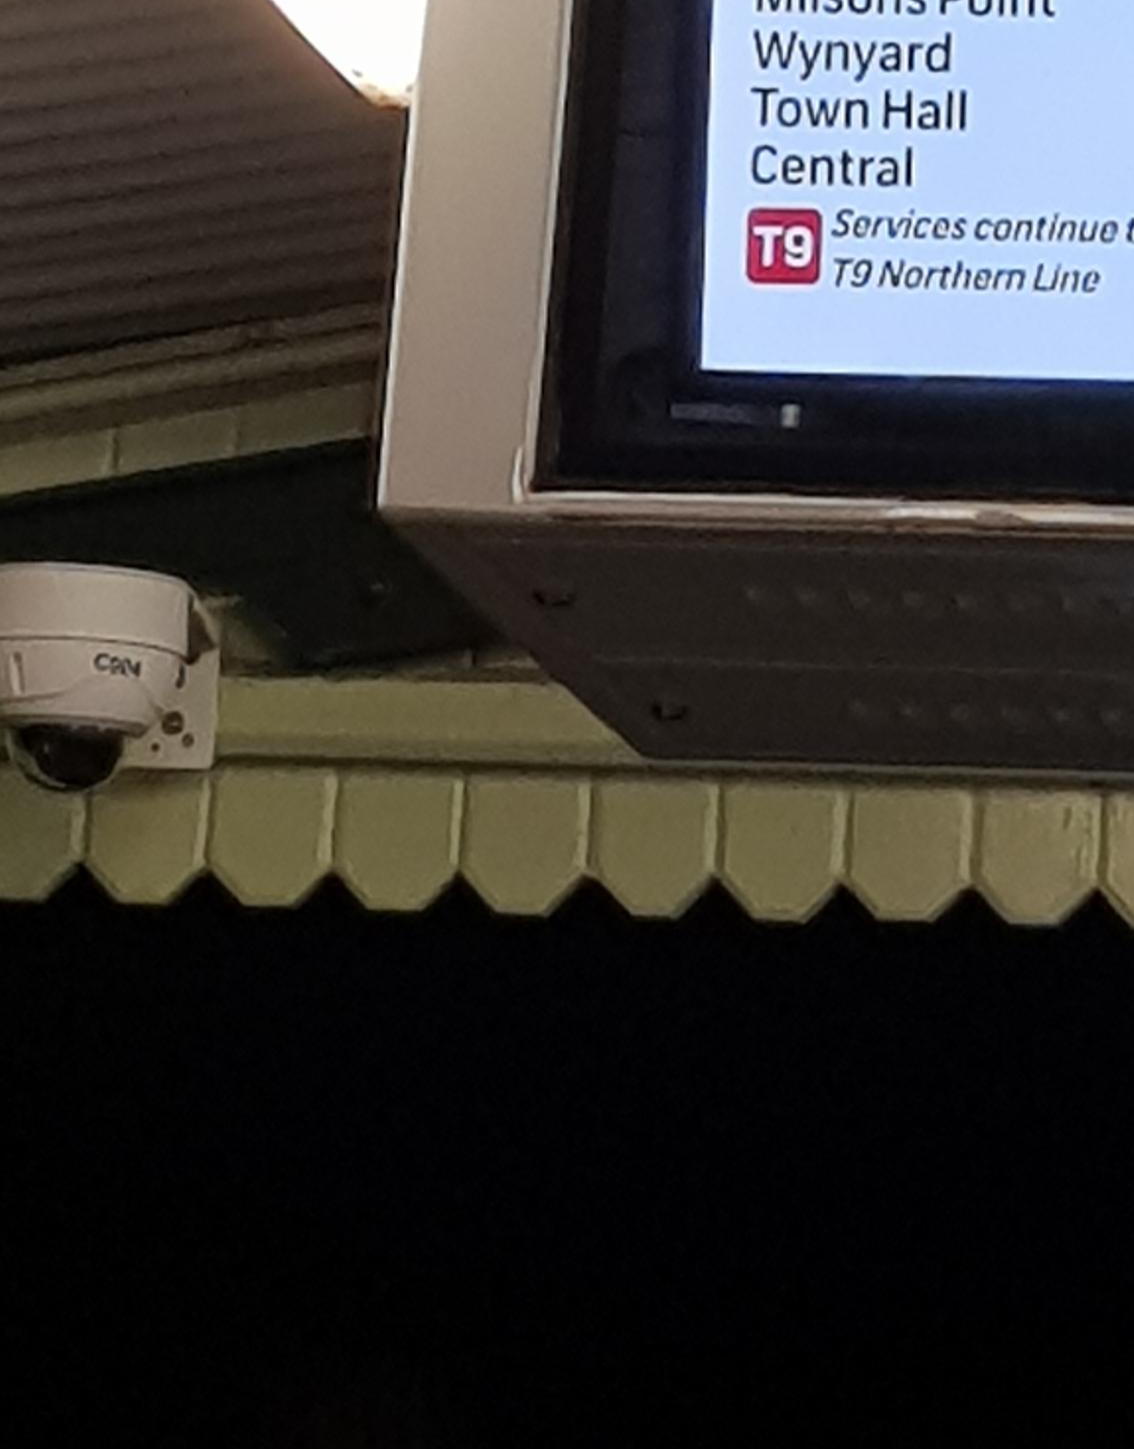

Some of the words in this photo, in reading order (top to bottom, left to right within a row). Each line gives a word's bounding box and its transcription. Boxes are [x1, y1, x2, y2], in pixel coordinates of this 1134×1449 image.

[753, 30, 952, 82] Wynyard
[750, 87, 869, 129] Town
[883, 90, 967, 130] Hall
[751, 144, 912, 187] Central
[752, 225, 814, 268] T9
[831, 208, 967, 240] Services
[974, 213, 1119, 243] continue
[832, 258, 873, 289] T9
[878, 260, 1026, 291] Northern
[1033, 263, 1101, 293] Line
